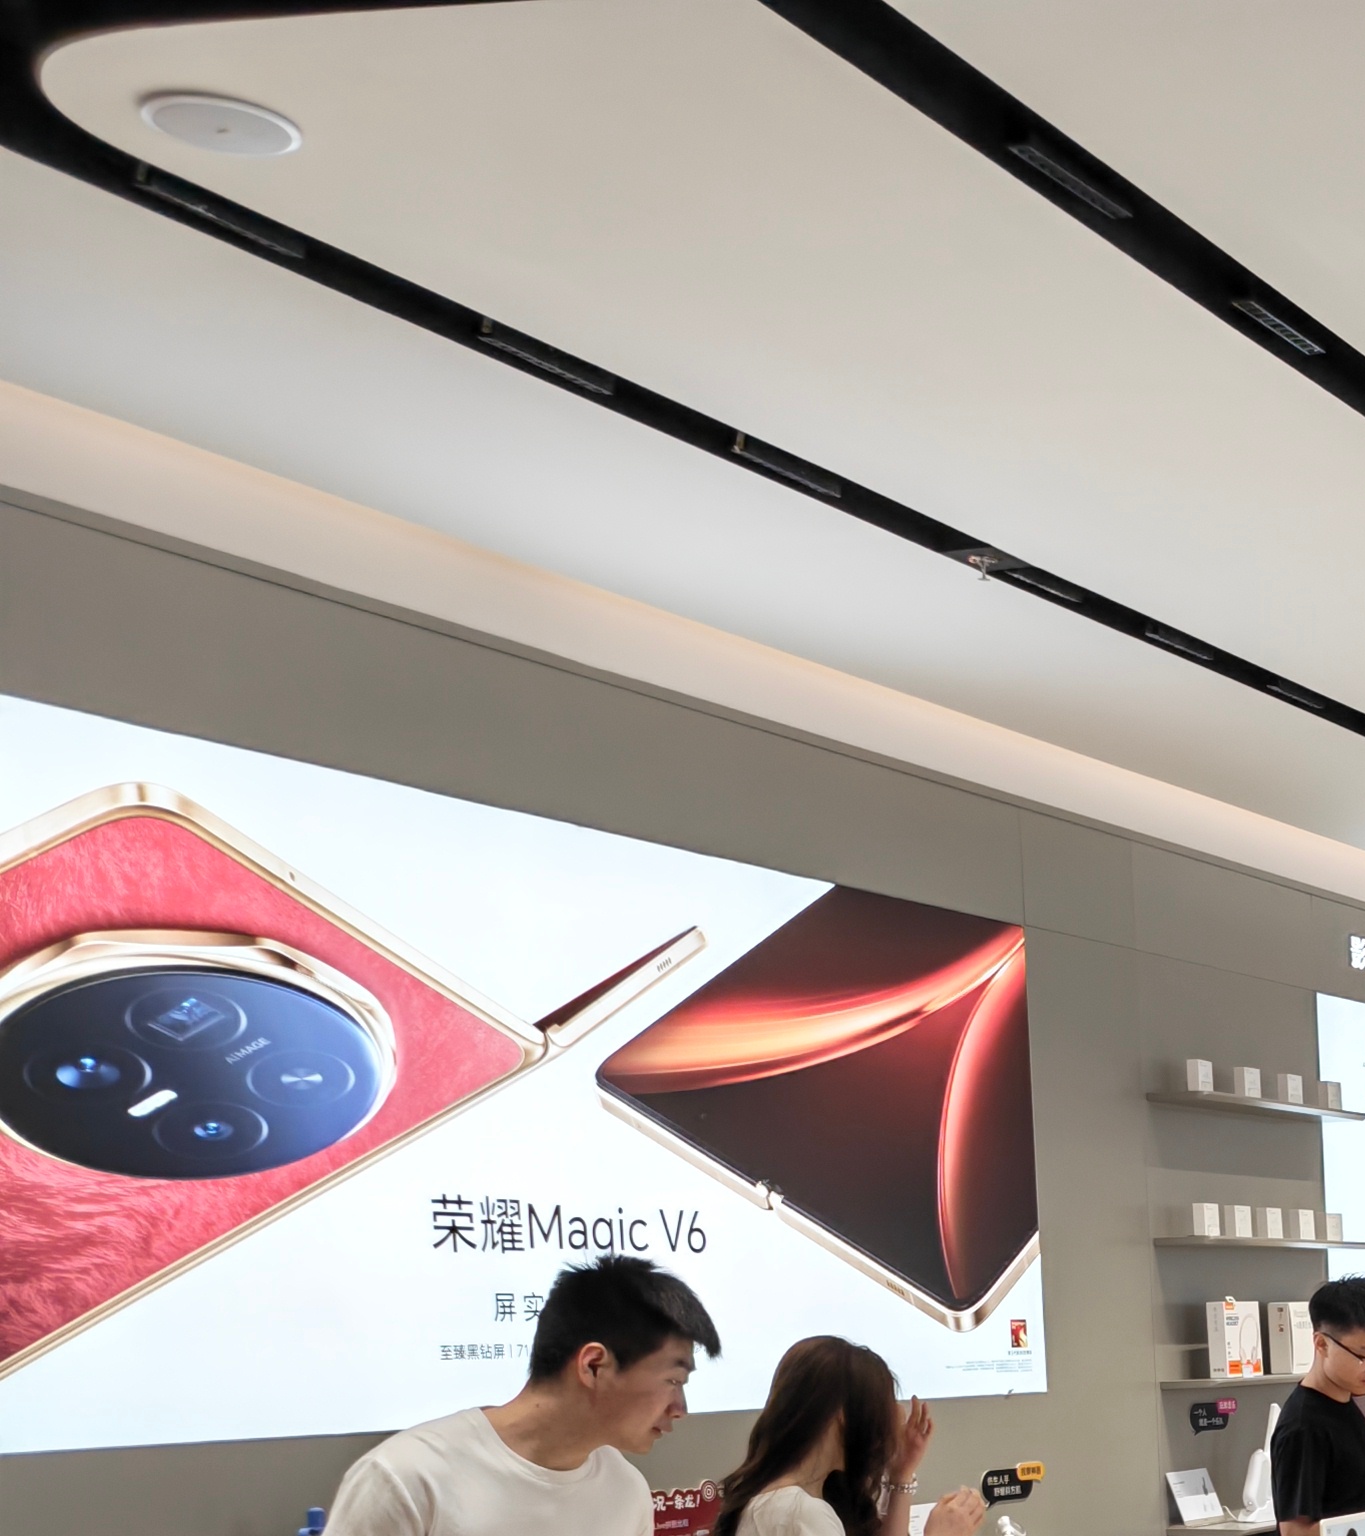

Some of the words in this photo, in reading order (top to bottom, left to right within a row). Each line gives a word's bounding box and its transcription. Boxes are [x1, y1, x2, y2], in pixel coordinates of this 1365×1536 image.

[431, 1194, 649, 1254] 荣耀Magic
[659, 1209, 707, 1254] V6
[440, 1344, 505, 1361] 至臻黑钻屏
